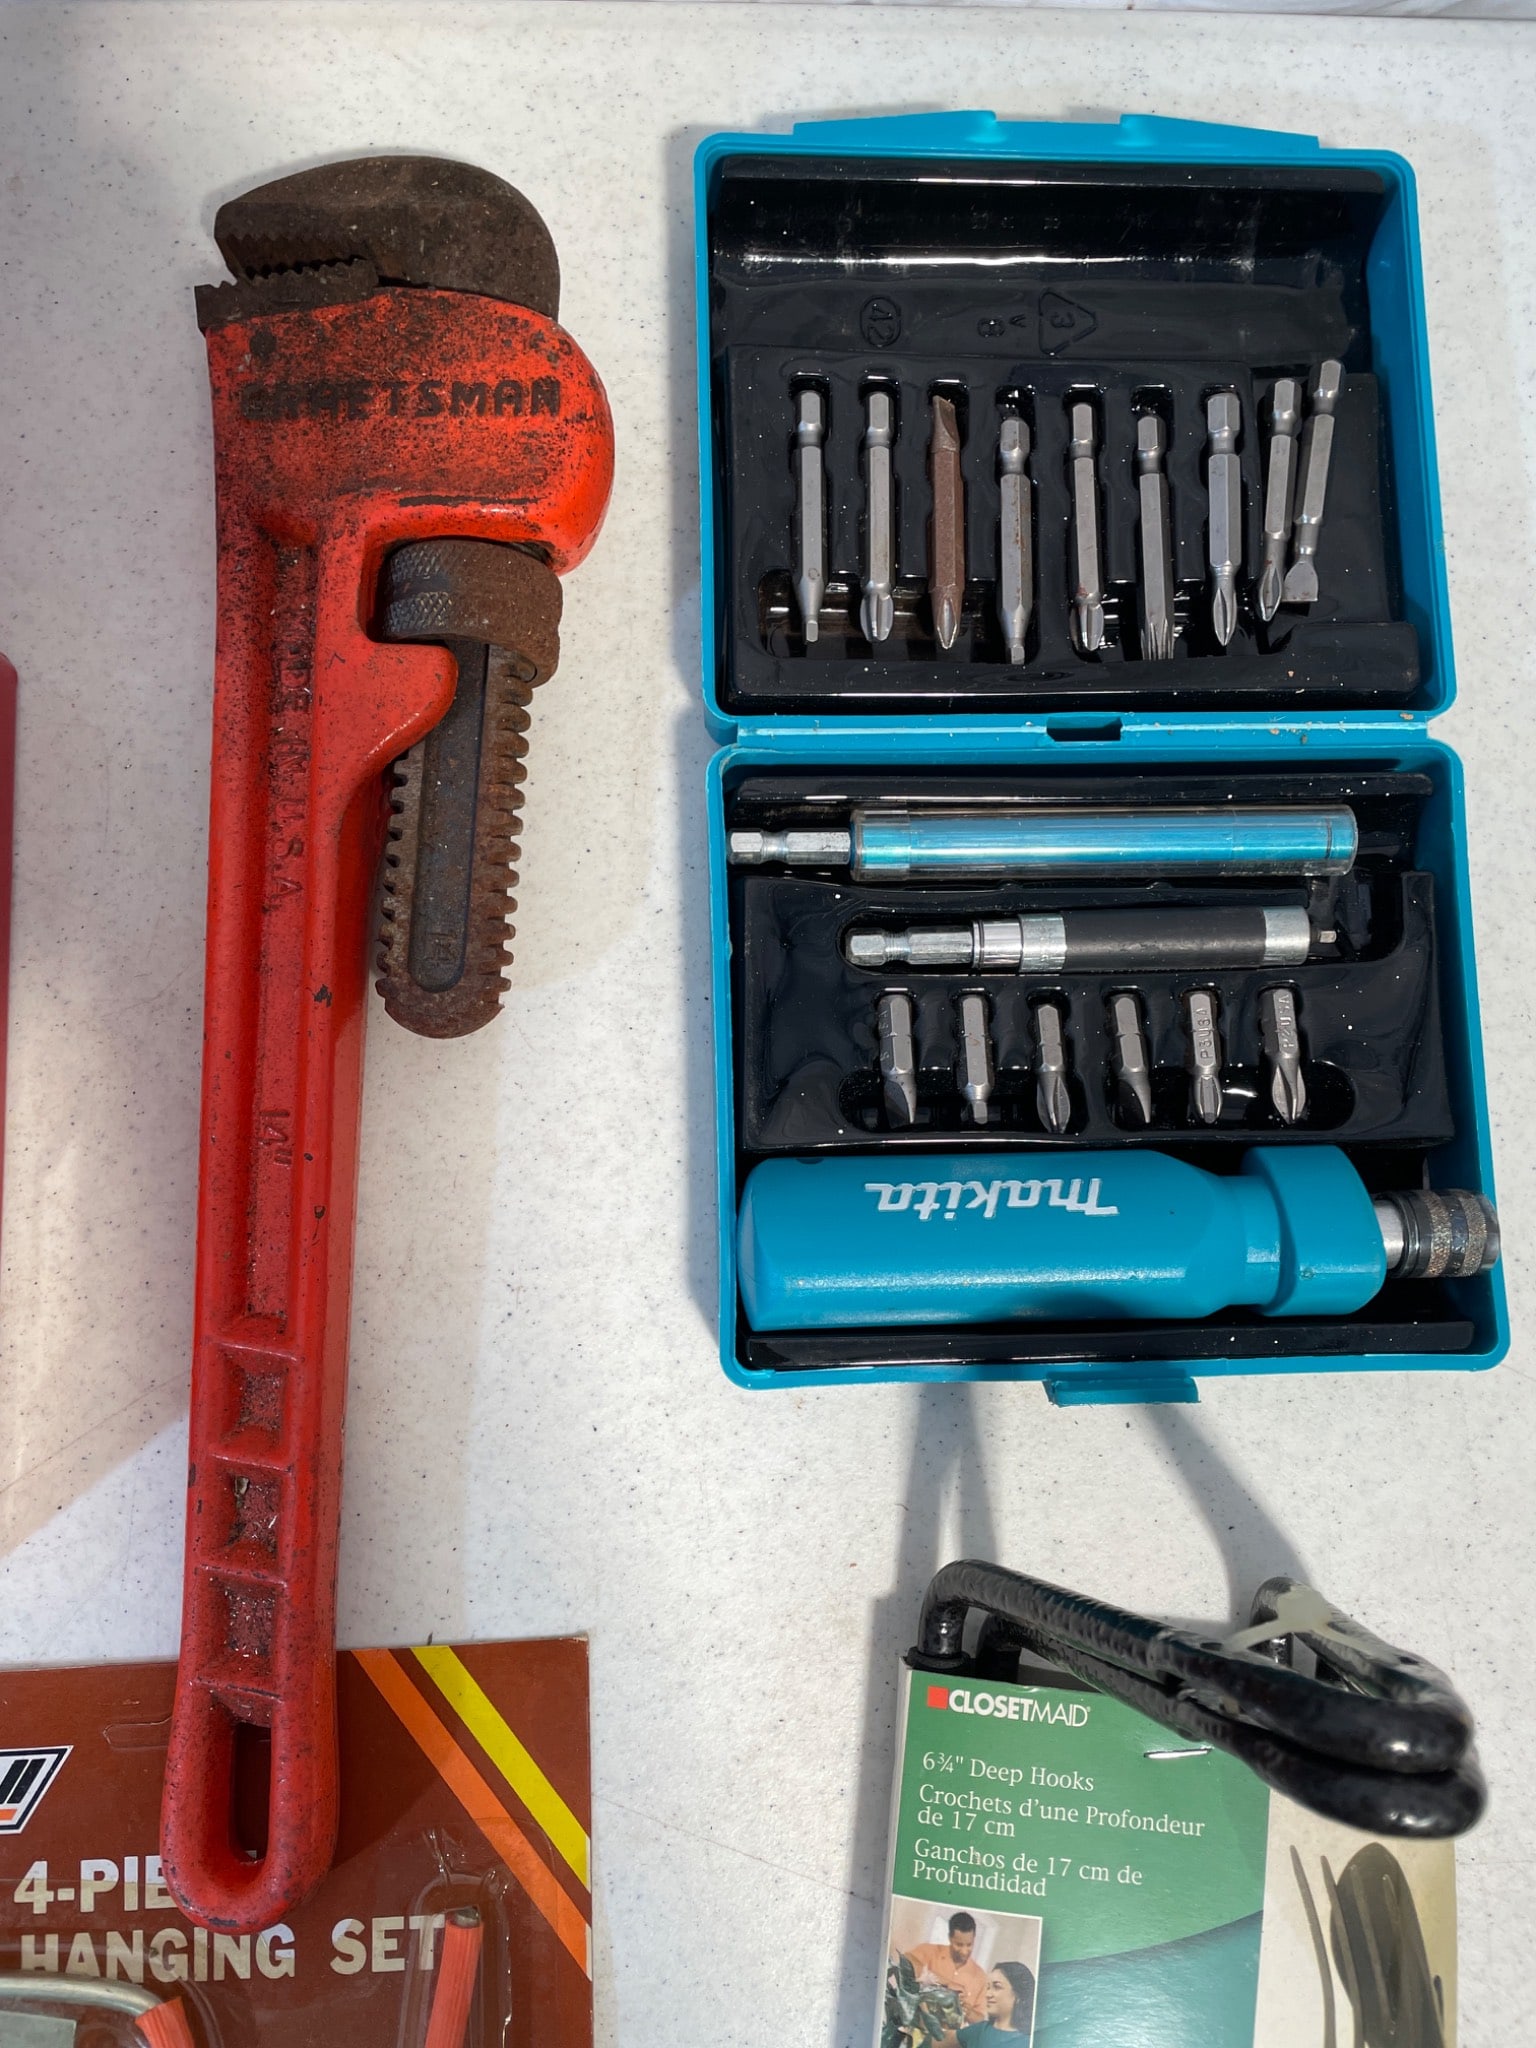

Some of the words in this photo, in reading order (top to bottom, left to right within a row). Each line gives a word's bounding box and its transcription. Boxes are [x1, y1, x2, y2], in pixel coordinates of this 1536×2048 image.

[970, 1758, 1024, 1787] Deep
[1030, 1765, 1095, 1792] Hooks
[917, 1805, 944, 1827] de
[951, 1810, 978, 1832] 17
[984, 1819, 1016, 1838] cm
[919, 1783, 1013, 1816] Crochets
[1086, 1804, 1206, 1837] Profondeur
[912, 1859, 1048, 1898] Profundidad
[914, 1837, 1006, 1870] Ganchos
[1012, 1852, 1039, 1874] de
[1047, 1856, 1073, 1878] 17
[1078, 1864, 1110, 1882] cm
[1116, 1864, 1144, 1886] de
[19, 1922, 296, 1983] HANGING
[329, 1913, 446, 1976] SET
